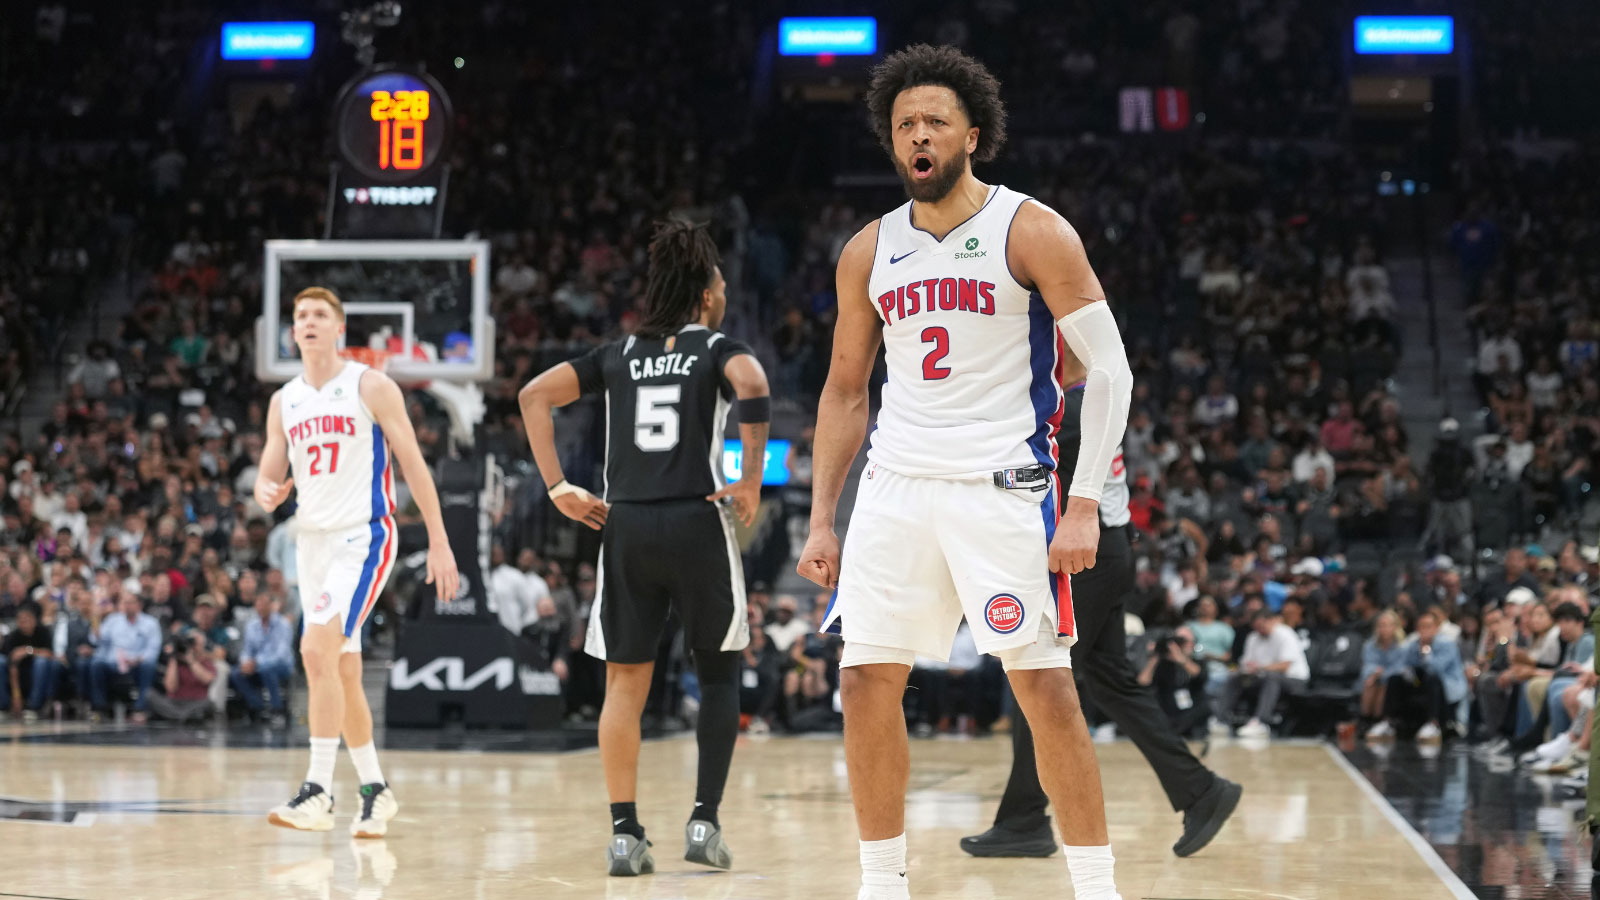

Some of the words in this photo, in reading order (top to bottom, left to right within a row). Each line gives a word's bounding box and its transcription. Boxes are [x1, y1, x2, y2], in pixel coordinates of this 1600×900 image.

[371, 90, 429, 121] 2:28
[379, 120, 423, 170] 18
[368, 187, 437, 205] TISSOT
[954, 250, 988, 260] StockX
[878, 277, 996, 327] PISTONS
[629, 353, 698, 380] CASTLE
[921, 326, 951, 380] 2
[289, 415, 355, 447] PISTONS
[634, 384, 681, 453] 5
[307, 442, 339, 476] 27
[992, 605, 1016, 615] DETROIT
[992, 612, 1017, 622] PISTONS
